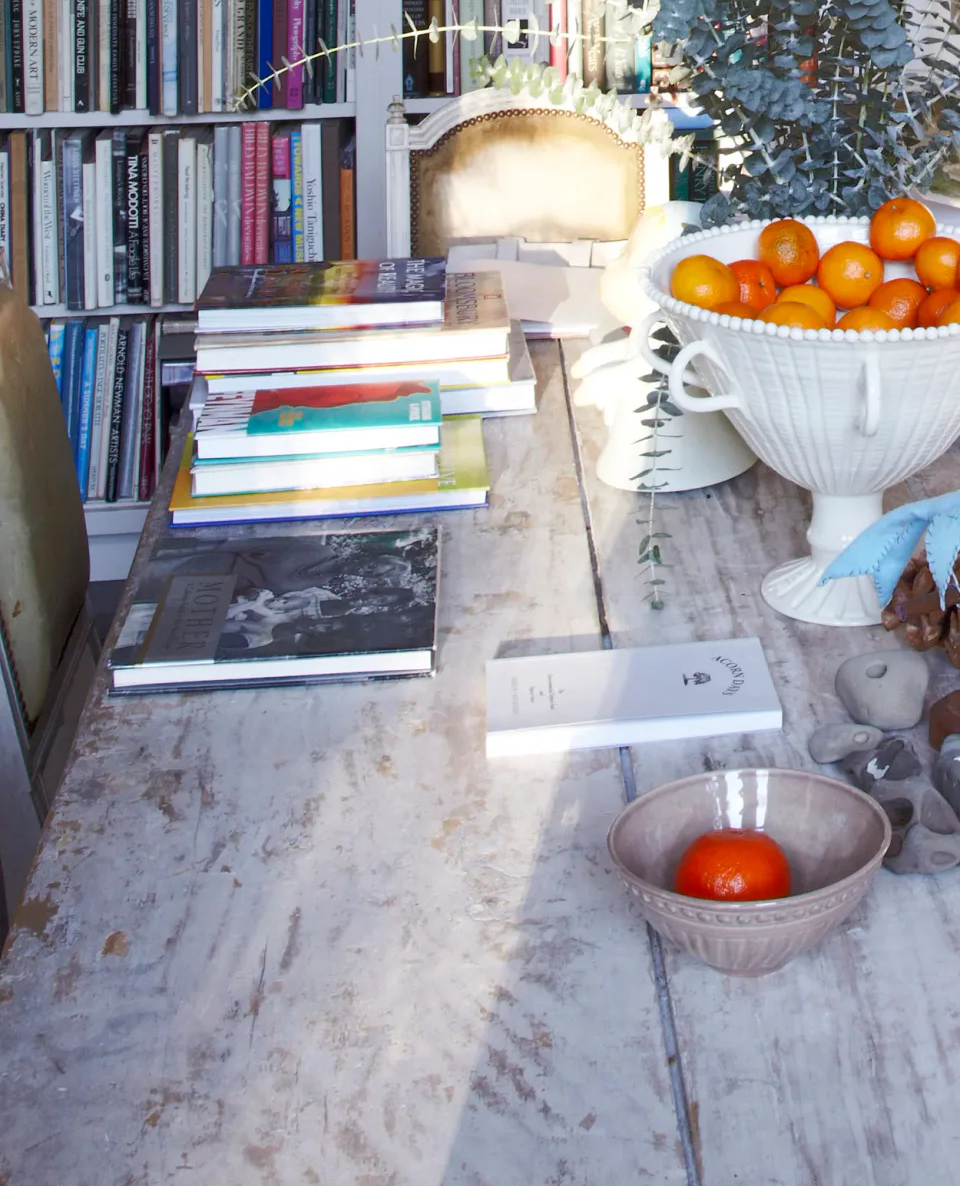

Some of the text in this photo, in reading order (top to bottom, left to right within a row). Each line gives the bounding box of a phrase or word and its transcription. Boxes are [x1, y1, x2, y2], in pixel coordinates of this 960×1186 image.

[28, 10, 38, 81] MODERN ART
[76, 20, 86, 36] AND
[76, 38, 86, 53] GUN
[236, 7, 246, 53] GRANDE
[291, 18, 303, 61] Photographs
[76, 55, 86, 74] CLUB
[43, 170, 53, 240] Women the West
[243, 127, 256, 262] BILLY BALDWIN decorates
[255, 127, 268, 262] BILLY BALDWIN decorates
[294, 141, 303, 231] TOWARDS NEW
[127, 155, 140, 281] TINA MODOTTI A Fragile Life
[306, 178, 318, 263] Yoshio Taniguchi
[379, 262, 395, 272] OF
[407, 260, 424, 273] THE
[456, 272, 479, 326] BLOOMSBURY
[94, 332, 107, 426] PORTRAITS MORATH
[109, 334, 127, 464] ARNOLD NEWMAN ARTISTS
[81, 389, 90, 432] SUMMER'S
[178, 581, 225, 651] MOTHER
[711, 655, 745, 697] ACORN DAYS
